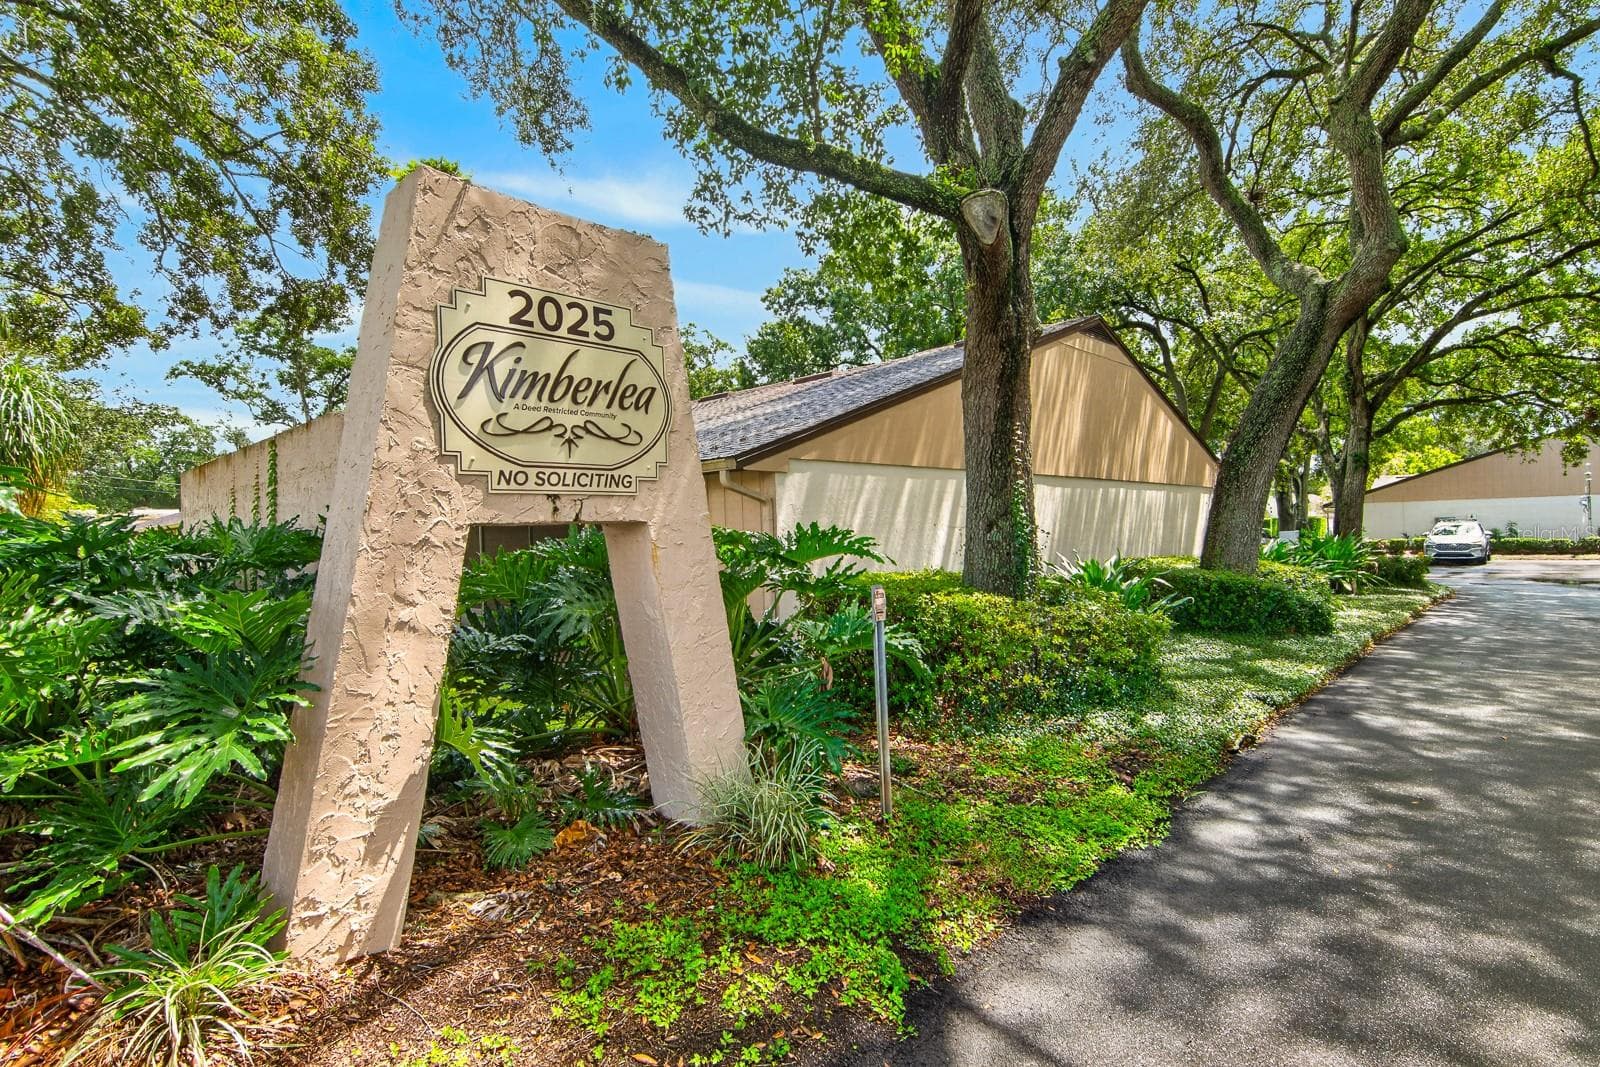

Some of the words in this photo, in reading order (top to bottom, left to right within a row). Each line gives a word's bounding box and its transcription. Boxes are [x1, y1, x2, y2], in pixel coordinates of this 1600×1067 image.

[507, 289, 615, 342] 2025
[457, 341, 656, 415] Kimberlea
[521, 403, 542, 412] Deed
[543, 406, 579, 416] Restricted
[580, 409, 618, 420] Community
[497, 470, 529, 487] NO
[534, 470, 633, 489] SOLICITING
